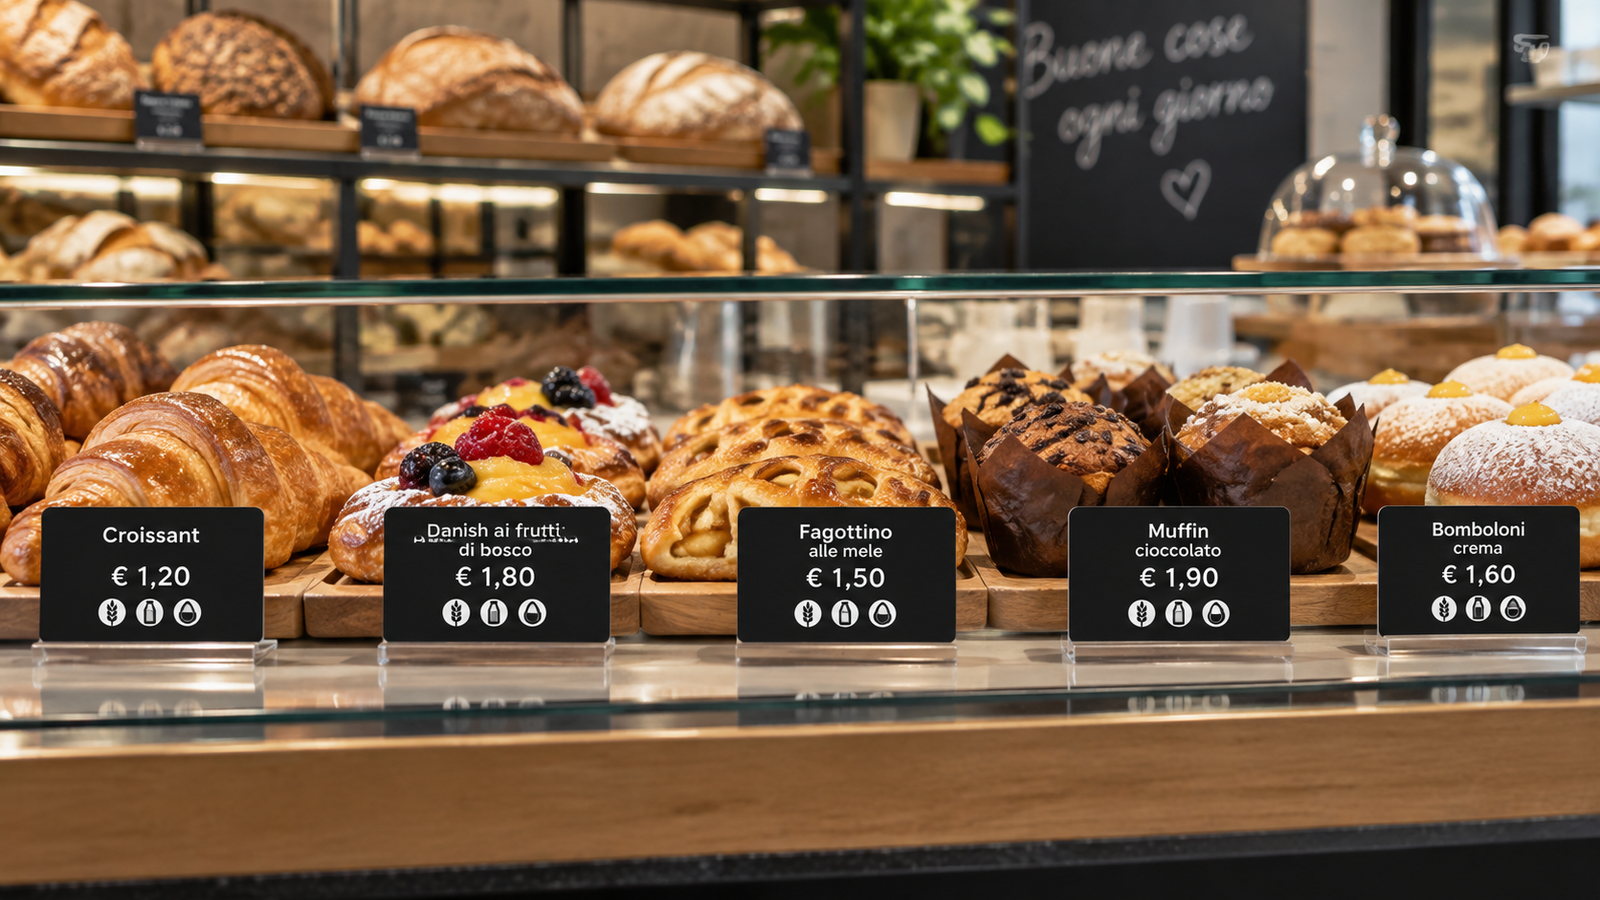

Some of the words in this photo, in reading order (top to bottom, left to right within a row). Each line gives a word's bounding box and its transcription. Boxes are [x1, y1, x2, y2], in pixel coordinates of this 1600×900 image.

[1023, 21, 1152, 99] Buone
[1164, 14, 1254, 63] cose
[1058, 85, 1145, 169] ogni
[1151, 75, 1273, 156] giorno
[102, 525, 200, 544] Croissant
[427, 522, 489, 538] Danish
[494, 522, 510, 538] ai
[515, 522, 562, 538] frutti
[799, 523, 893, 544] Fagottino
[1148, 522, 1209, 539] Muffin
[1432, 521, 1525, 537] Bomboloni
[459, 542, 475, 557] di
[481, 542, 533, 557] bosco
[808, 543, 838, 558] alle
[843, 543, 883, 558] mele
[1135, 542, 1222, 558] cioccolato
[1453, 543, 1503, 555] crema
[111, 566, 127, 587] €
[137, 565, 191, 590] 1,20
[455, 566, 472, 587] €
[481, 566, 535, 590] 1,80
[806, 567, 823, 588] €
[832, 567, 885, 591] 1,50
[1139, 567, 1156, 588] €
[1165, 567, 1219, 591] 1,90
[1442, 564, 1458, 584] €
[1465, 564, 1516, 588] 1,60
